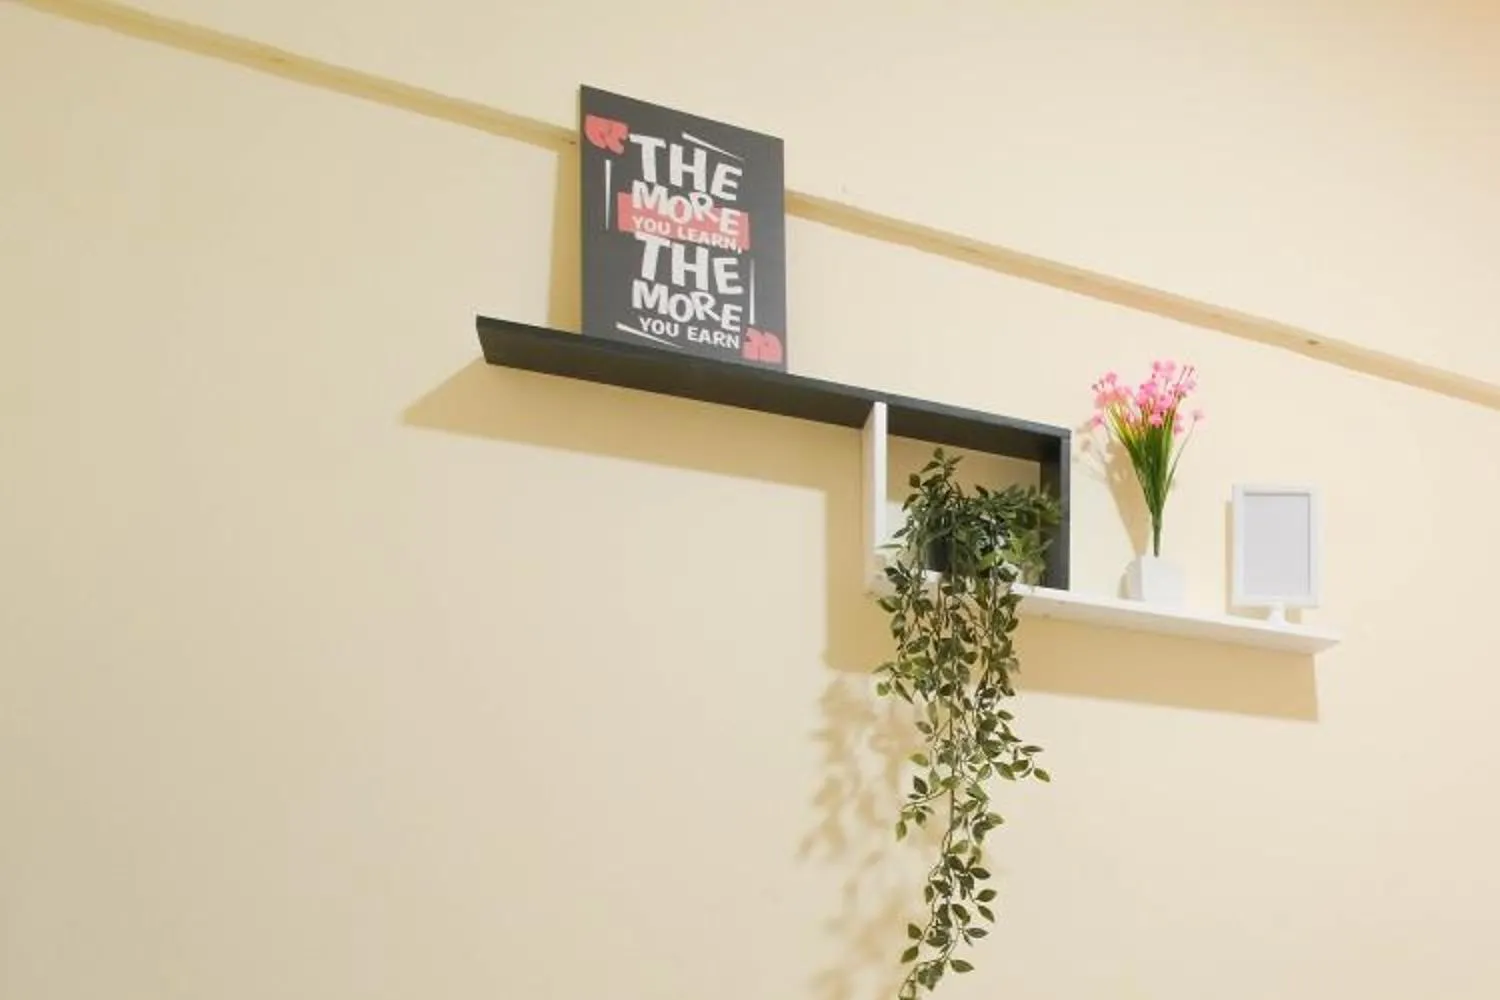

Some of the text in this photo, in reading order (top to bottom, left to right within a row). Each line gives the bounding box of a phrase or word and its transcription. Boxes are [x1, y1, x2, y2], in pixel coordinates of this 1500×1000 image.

[629, 133, 743, 201] THE
[631, 215, 671, 235] YOU
[632, 180, 741, 236] MORE
[635, 232, 744, 295] THE
[632, 279, 742, 333] MORE
[638, 317, 740, 349] YOU EARN
